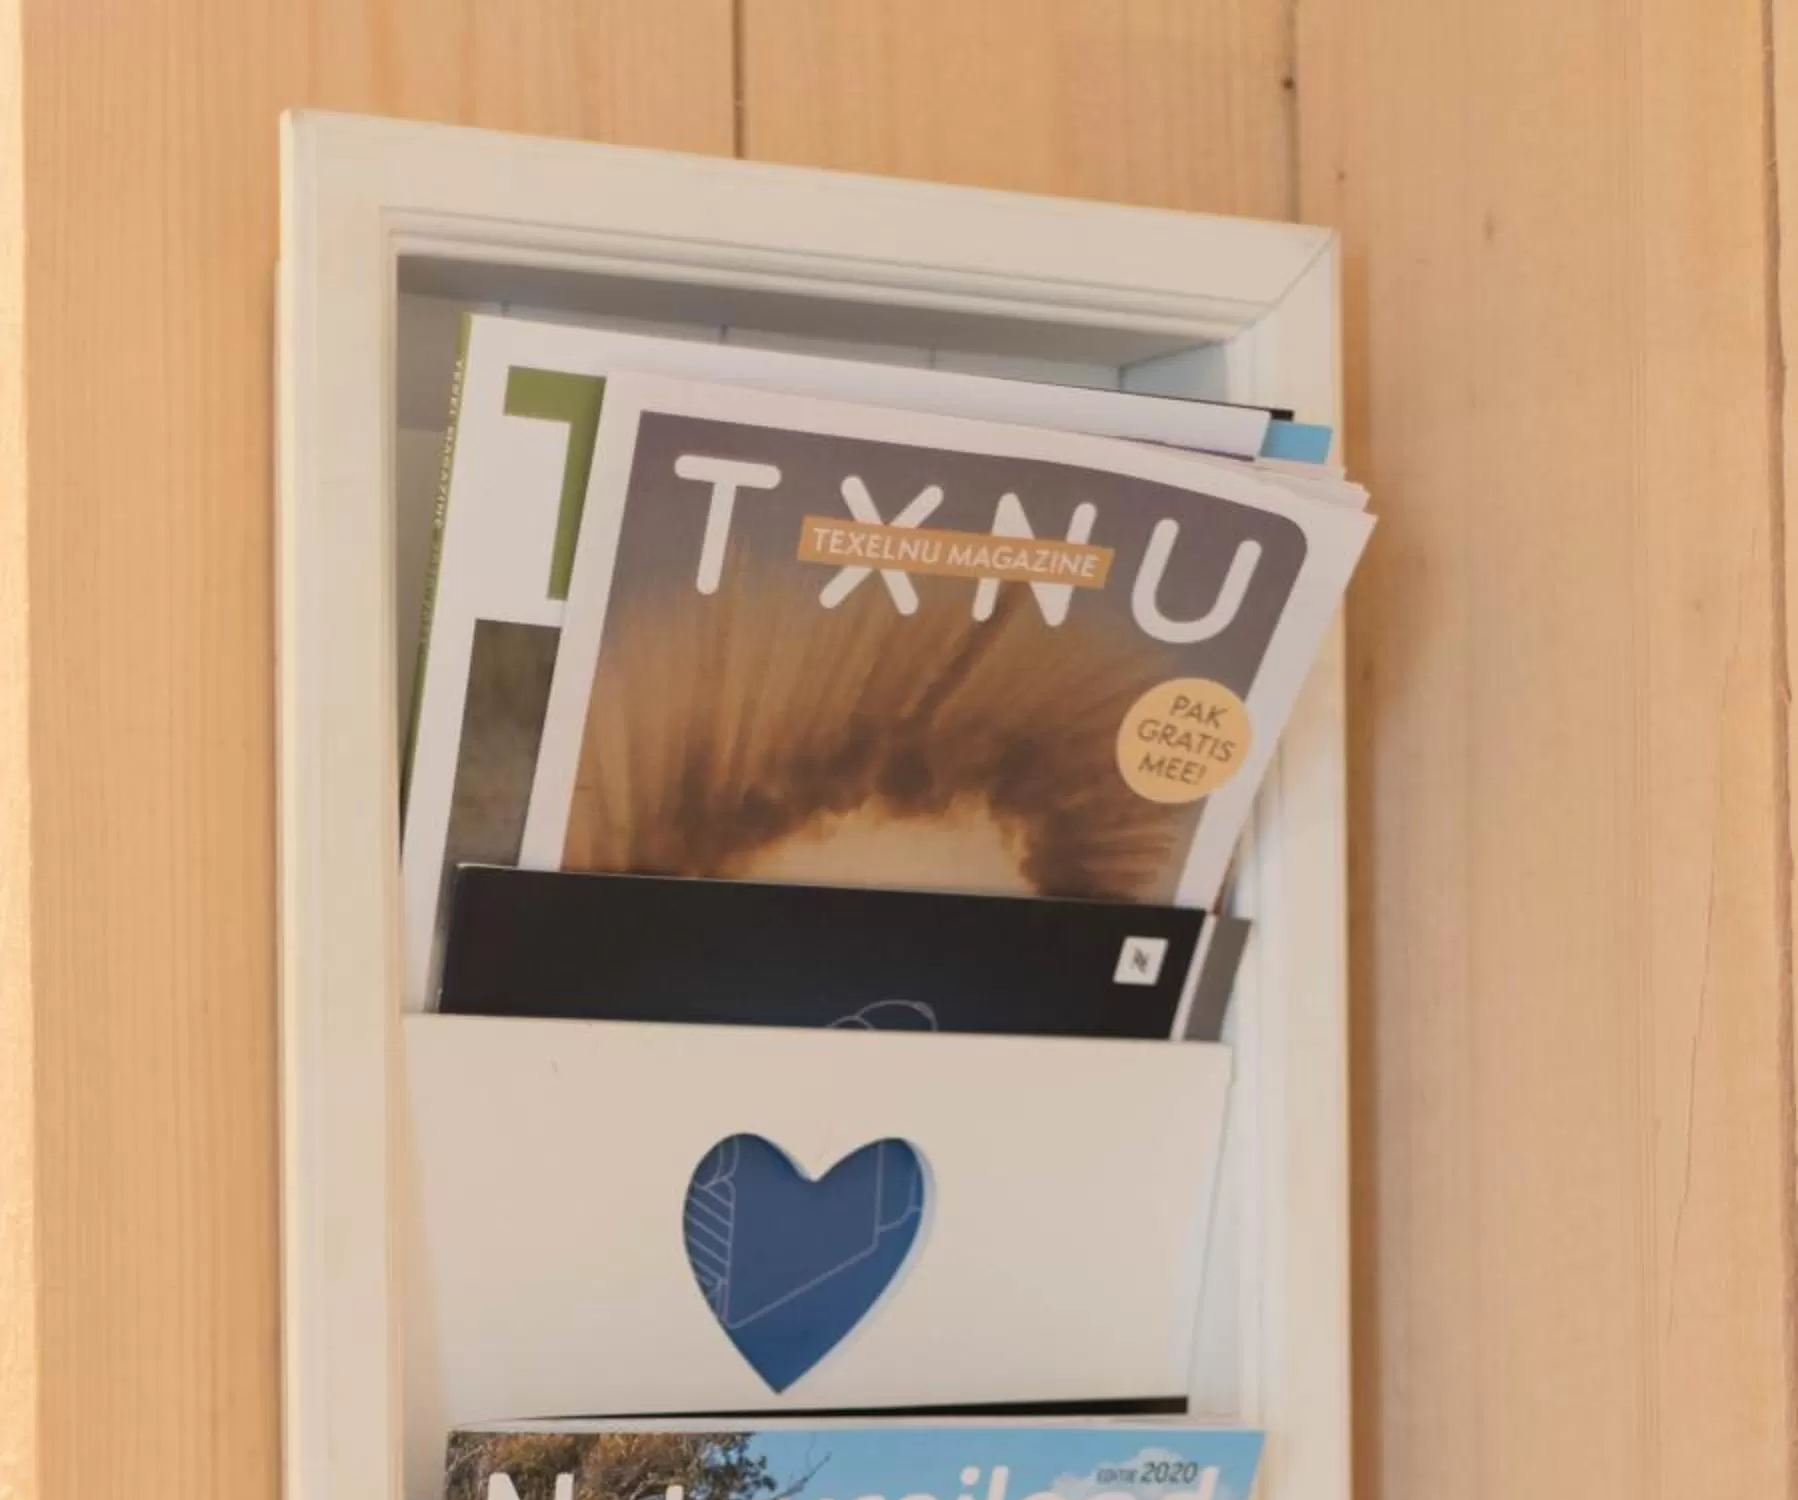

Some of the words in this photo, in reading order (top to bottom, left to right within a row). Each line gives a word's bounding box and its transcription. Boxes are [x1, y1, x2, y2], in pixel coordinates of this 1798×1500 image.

[674, 454, 1262, 644] TXNU
[813, 527, 940, 564] TEXELNU
[946, 543, 1100, 579] MAGAZINE
[1169, 695, 1230, 731] PAK
[1137, 719, 1236, 766] GRATIS
[1137, 753, 1209, 787] MEE!
[1140, 1460, 1199, 1484] 2020
